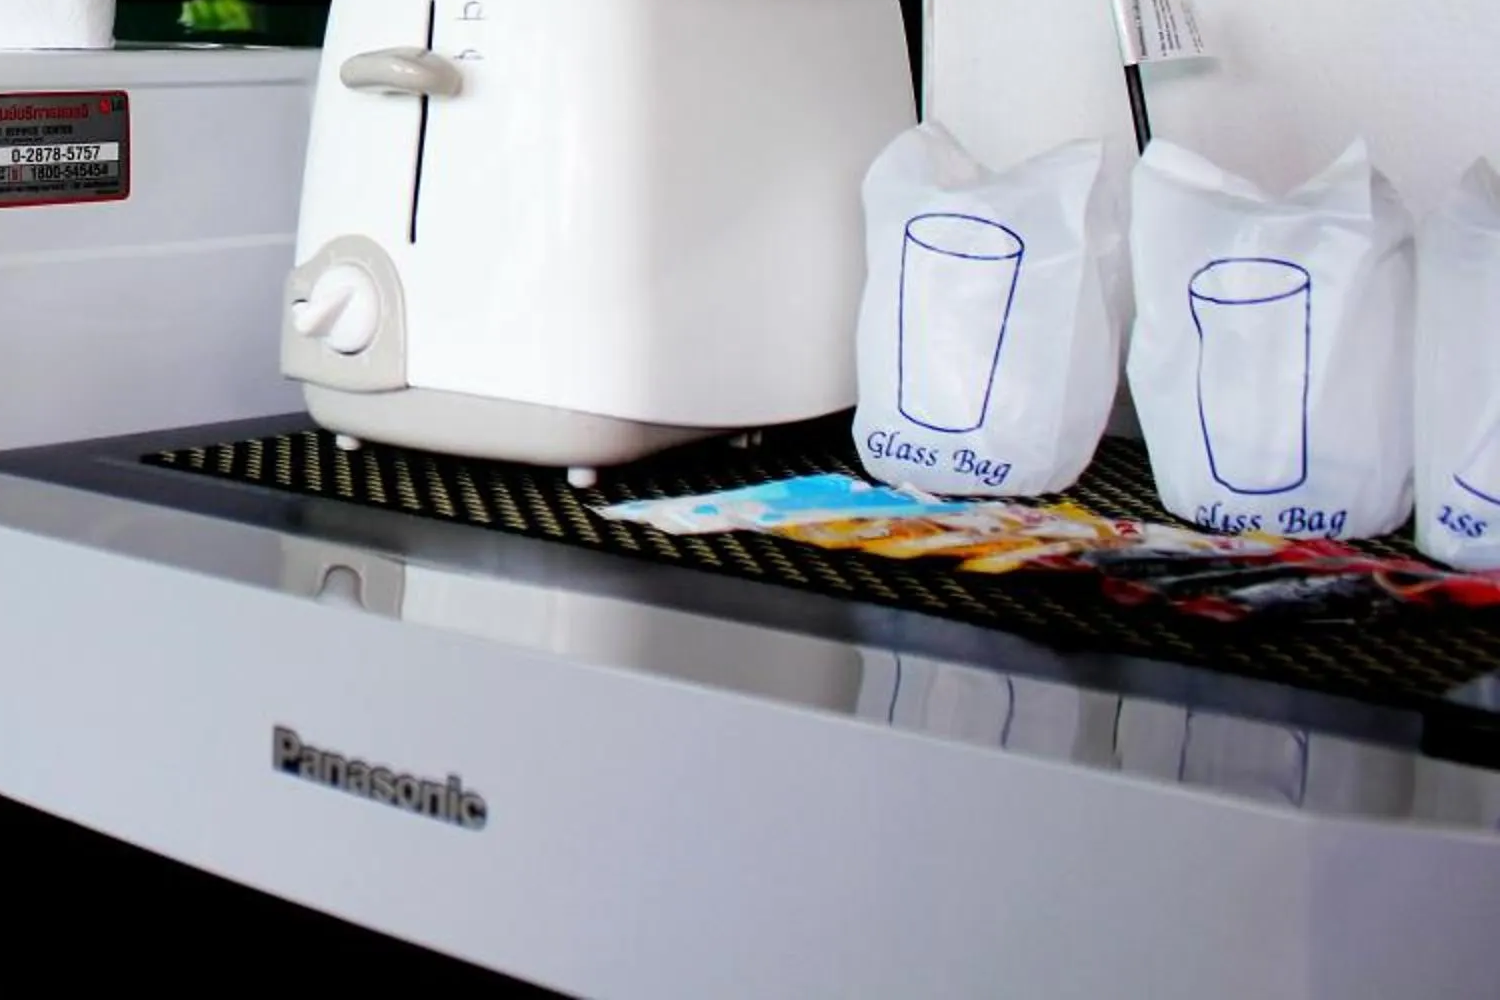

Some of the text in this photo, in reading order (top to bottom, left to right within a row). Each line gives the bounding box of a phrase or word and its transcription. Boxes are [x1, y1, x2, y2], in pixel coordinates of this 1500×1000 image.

[11, 146, 101, 163] 0-2878-5757
[867, 430, 1012, 487] Glass Bag
[1278, 506, 1348, 539] Bag
[273, 724, 488, 832] Panasonic
